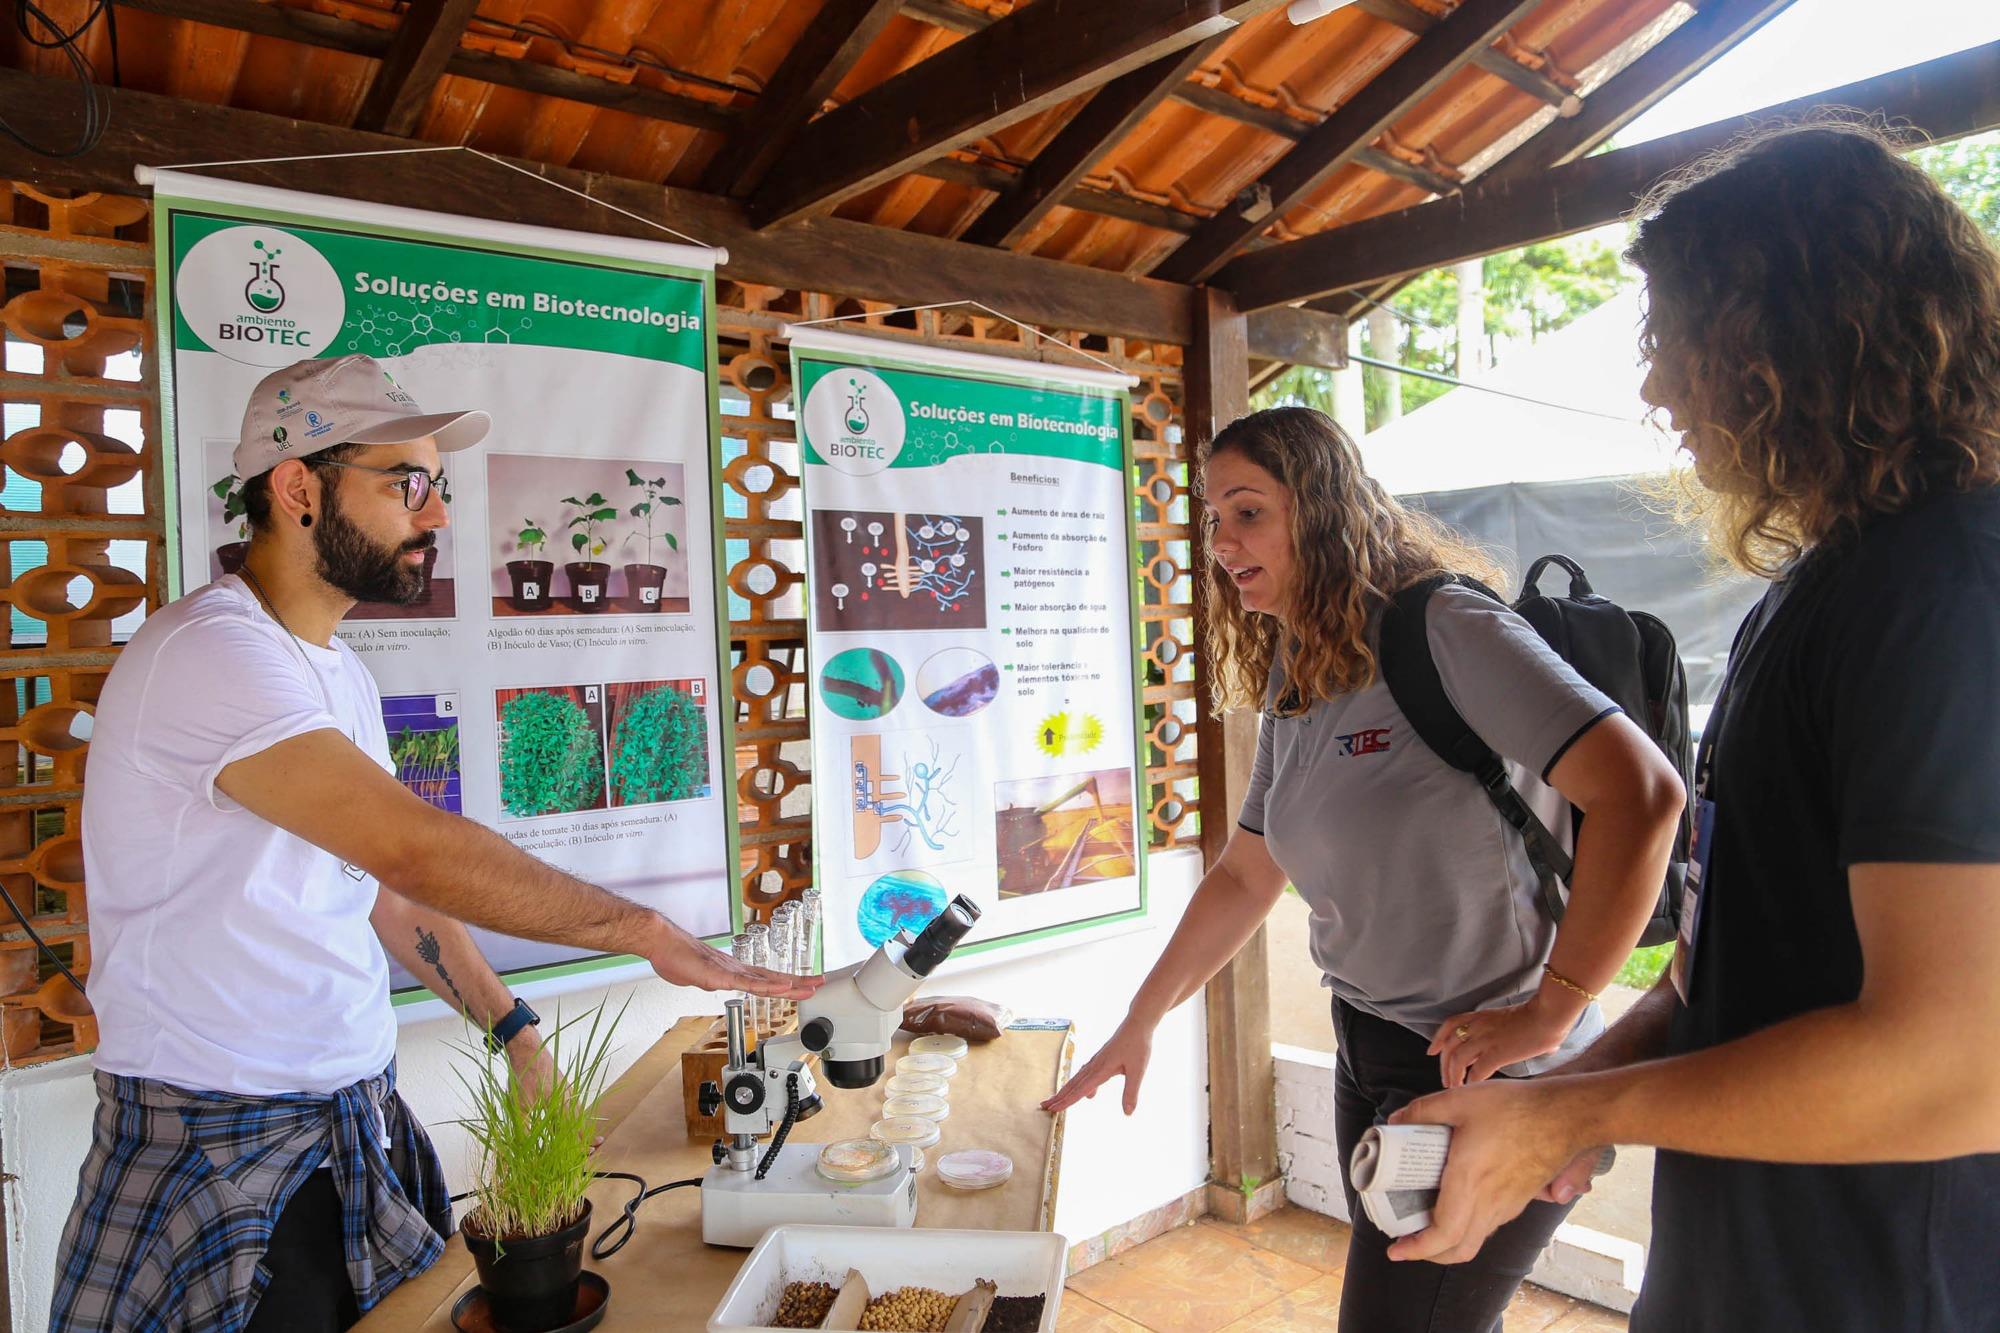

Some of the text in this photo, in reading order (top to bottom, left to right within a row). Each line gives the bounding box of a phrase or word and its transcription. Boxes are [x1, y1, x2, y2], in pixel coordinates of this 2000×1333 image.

[354, 272, 701, 333] Soluções em Biotecnologia
[236, 314, 296, 329] ambiento
[219, 323, 311, 347] BIOTEC
[909, 400, 1119, 441] Soluções em Biotecnologia
[276, 440, 294, 452] UEL
[830, 443, 885, 460] BIOTEC
[1011, 506, 1048, 517] Aumento
[1049, 509, 1060, 517] de
[1080, 510, 1091, 519] de
[1012, 531, 1049, 541] Aumento
[1061, 532, 1097, 544] absorção
[1012, 542, 1044, 552] Fósforo
[1013, 567, 1036, 576] Maior
[1038, 567, 1083, 576] resistência
[1013, 579, 1055, 589] patógenos
[526, 586, 535, 596] A
[585, 590, 593, 599] B
[645, 591, 653, 600] C
[1015, 603, 1037, 611] Maior
[1039, 603, 1077, 612] absorção
[358, 629, 375, 639] (A)
[377, 628, 398, 638] Sem
[400, 626, 451, 640] inoculação;
[487, 623, 696, 639] Algodão 60 dias após semeadura: (A) Sem inoculação;
[1015, 627, 1048, 636] Melhora
[1100, 626, 1110, 634] do
[375, 643, 385, 652] in
[387, 642, 411, 652] vitro.
[487, 637, 648, 651] (B) Inóculo de Vaso; (C) Inóculo in vitro.
[1016, 639, 1034, 648] solo
[1017, 663, 1040, 672] Maior
[1017, 674, 1060, 684] elementos
[1090, 672, 1101, 680] no
[694, 683, 701, 693] B
[1017, 688, 1035, 696] solo
[588, 691, 596, 701] A
[445, 701, 453, 711] B
[530, 829, 540, 838] de
[541, 827, 569, 836] tomate
[571, 823, 581, 832] 30
[582, 822, 599, 832] dias
[600, 820, 619, 831] após
[620, 815, 663, 827] semeadura:
[664, 813, 678, 823] (A)
[568, 835, 582, 847] (B)
[584, 833, 615, 844] Inóculo
